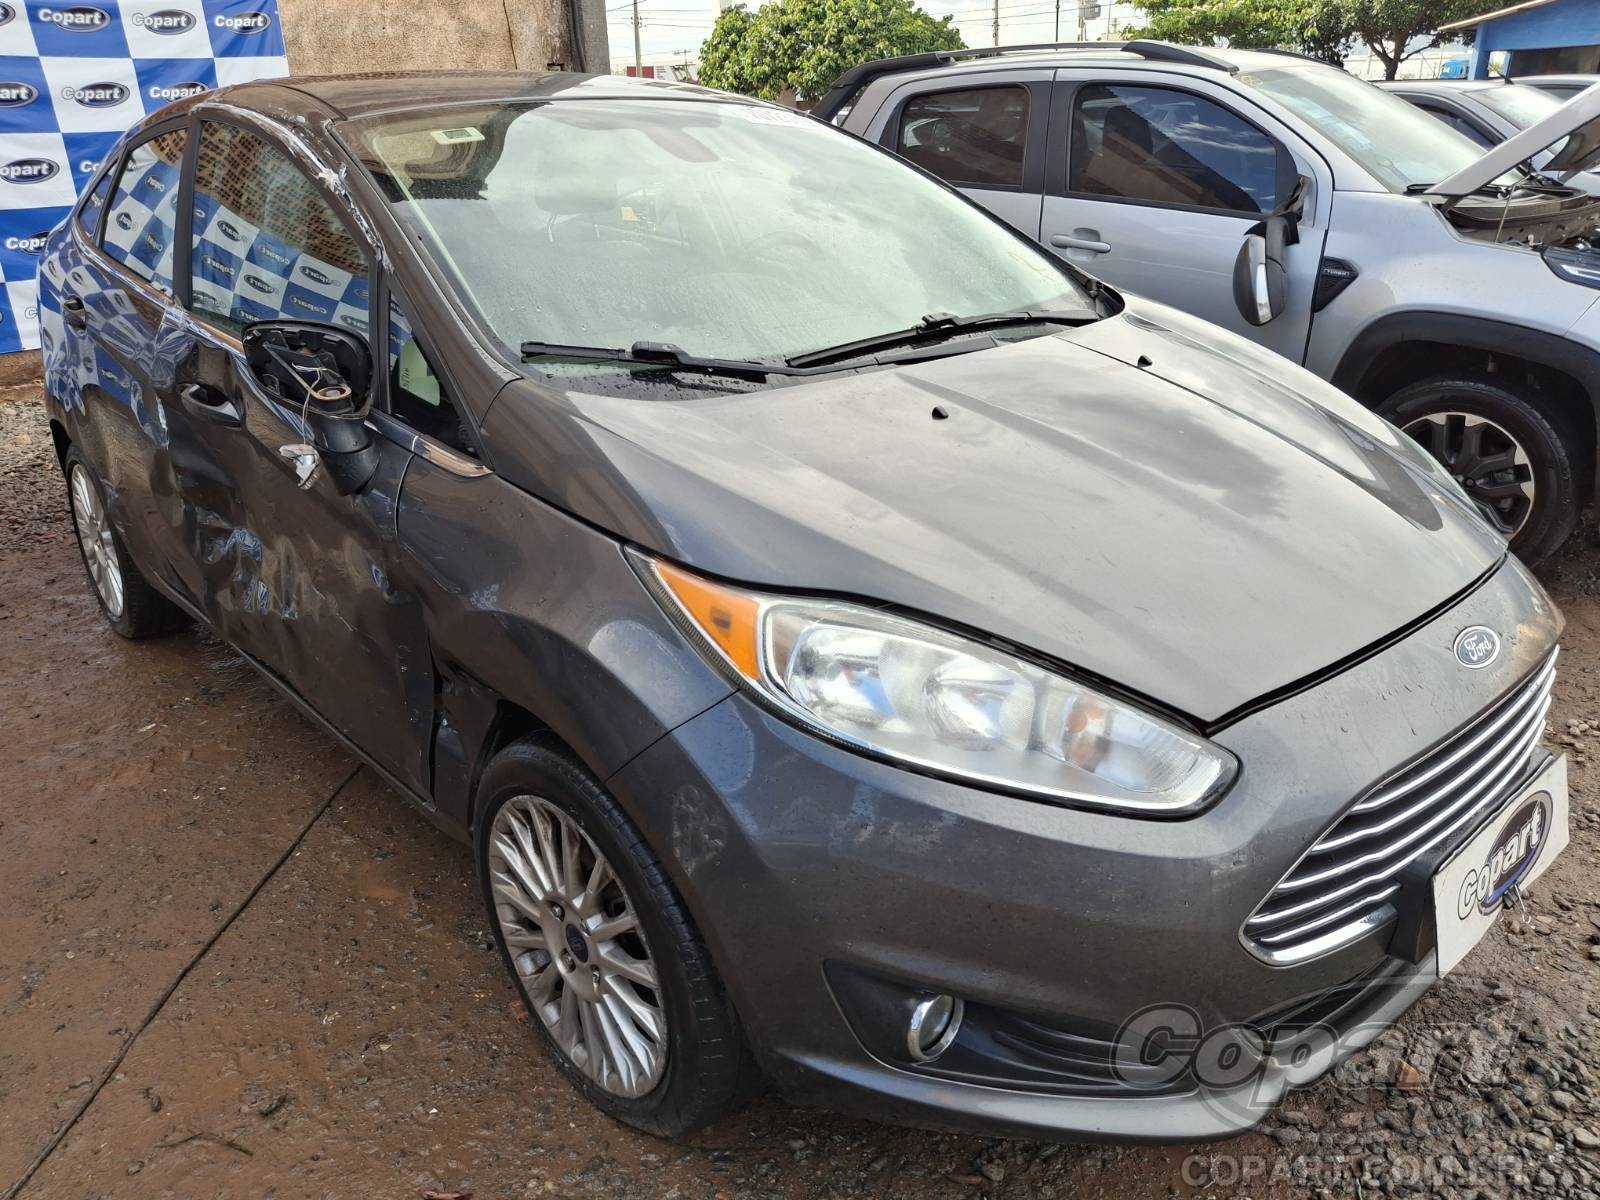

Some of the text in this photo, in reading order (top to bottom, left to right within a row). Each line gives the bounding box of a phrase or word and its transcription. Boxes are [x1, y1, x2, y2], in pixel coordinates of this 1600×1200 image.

[38, 8, 102, 26] Copart
[131, 12, 188, 27] Copart
[214, 14, 264, 28] Copart
[0, 86, 29, 100] art
[61, 86, 121, 102] Copart
[149, 85, 203, 99] Copart
[0, 162, 49, 179] opart
[1463, 634, 1492, 661] Ford
[1457, 799, 1542, 921] Copart
